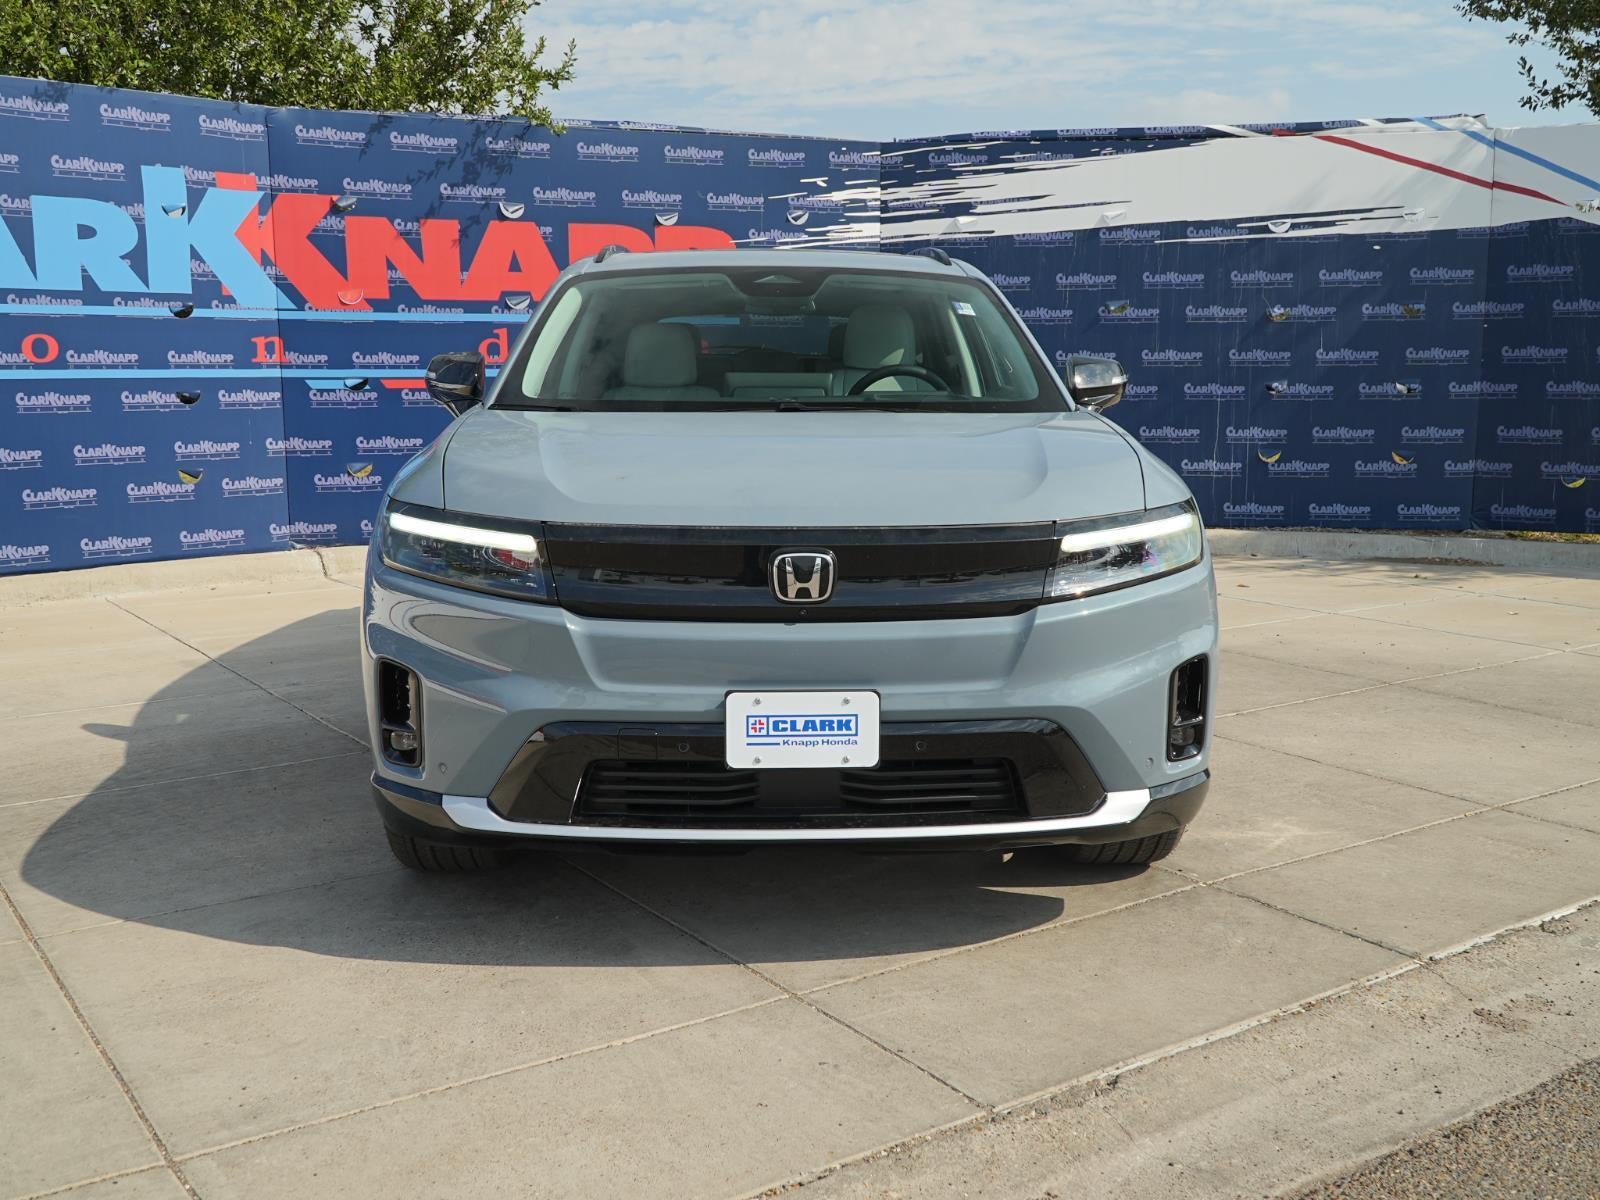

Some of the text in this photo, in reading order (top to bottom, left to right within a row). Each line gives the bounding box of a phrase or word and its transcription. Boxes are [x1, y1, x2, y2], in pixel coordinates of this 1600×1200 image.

[0, 93, 69, 113] LARKKNAPP
[250, 172, 318, 188] LARKKNAPP
[772, 719, 853, 733] CLARK
[782, 738, 858, 748] Knapp Honda
